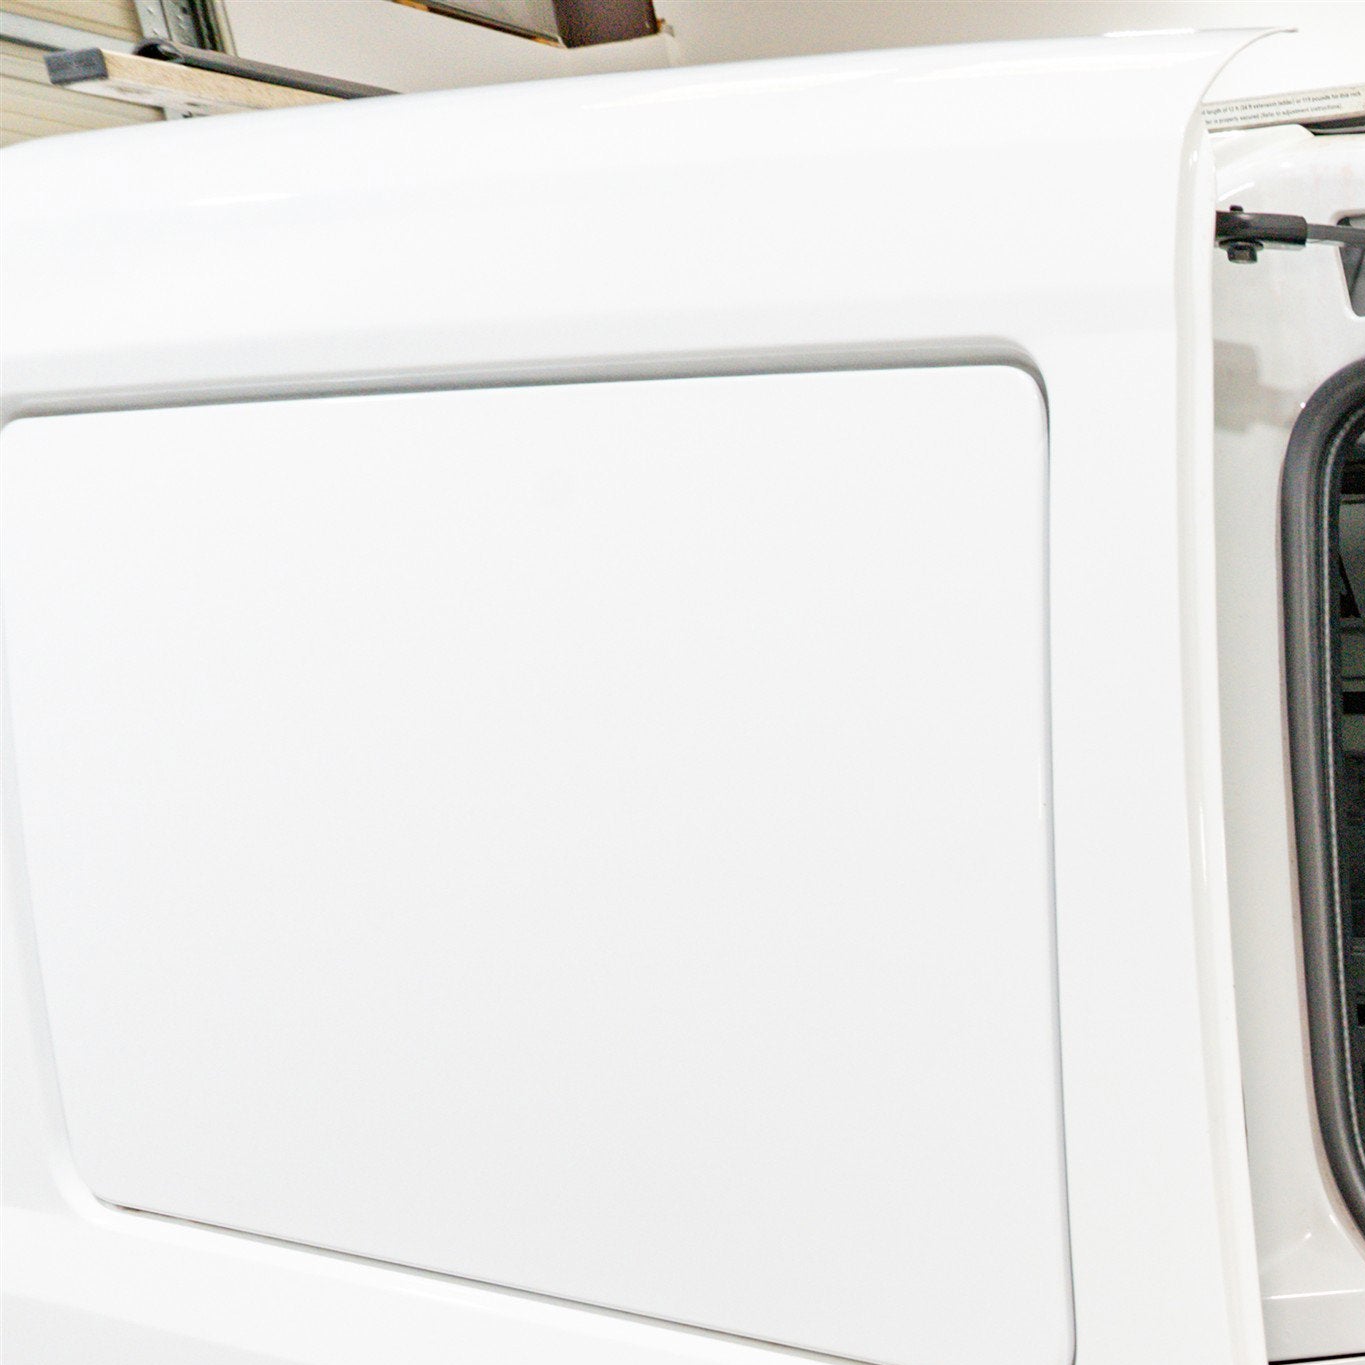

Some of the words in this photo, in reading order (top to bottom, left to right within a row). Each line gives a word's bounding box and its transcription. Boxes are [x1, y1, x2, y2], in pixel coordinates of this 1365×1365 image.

[1207, 107, 1222, 117] length
[1253, 101, 1278, 110] extension
[1311, 94, 1331, 103] pounds
[1218, 115, 1239, 125] properly
[1239, 113, 1260, 121] secured
[1281, 107, 1310, 117] adjustment
